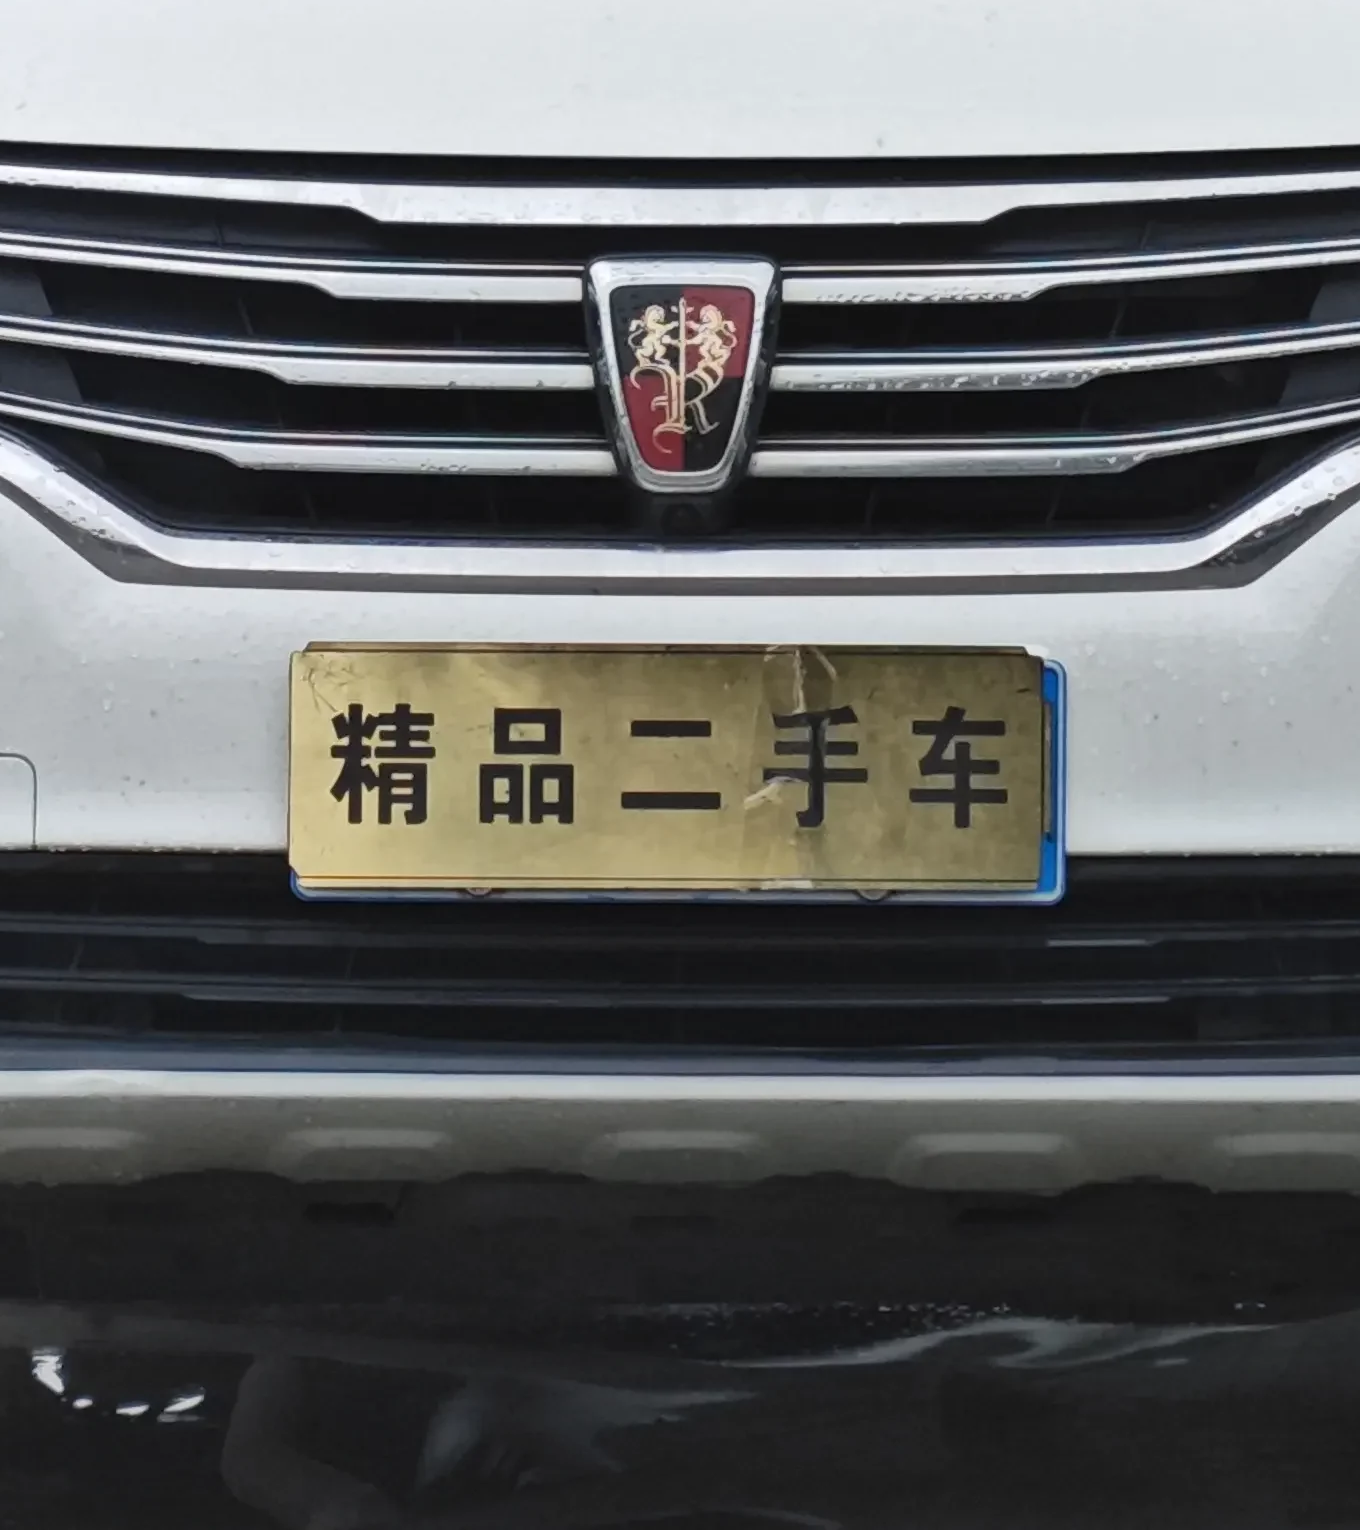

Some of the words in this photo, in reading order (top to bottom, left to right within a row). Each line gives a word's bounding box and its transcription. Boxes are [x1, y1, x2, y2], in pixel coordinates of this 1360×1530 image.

[330, 702, 1008, 829] 精品二手车
